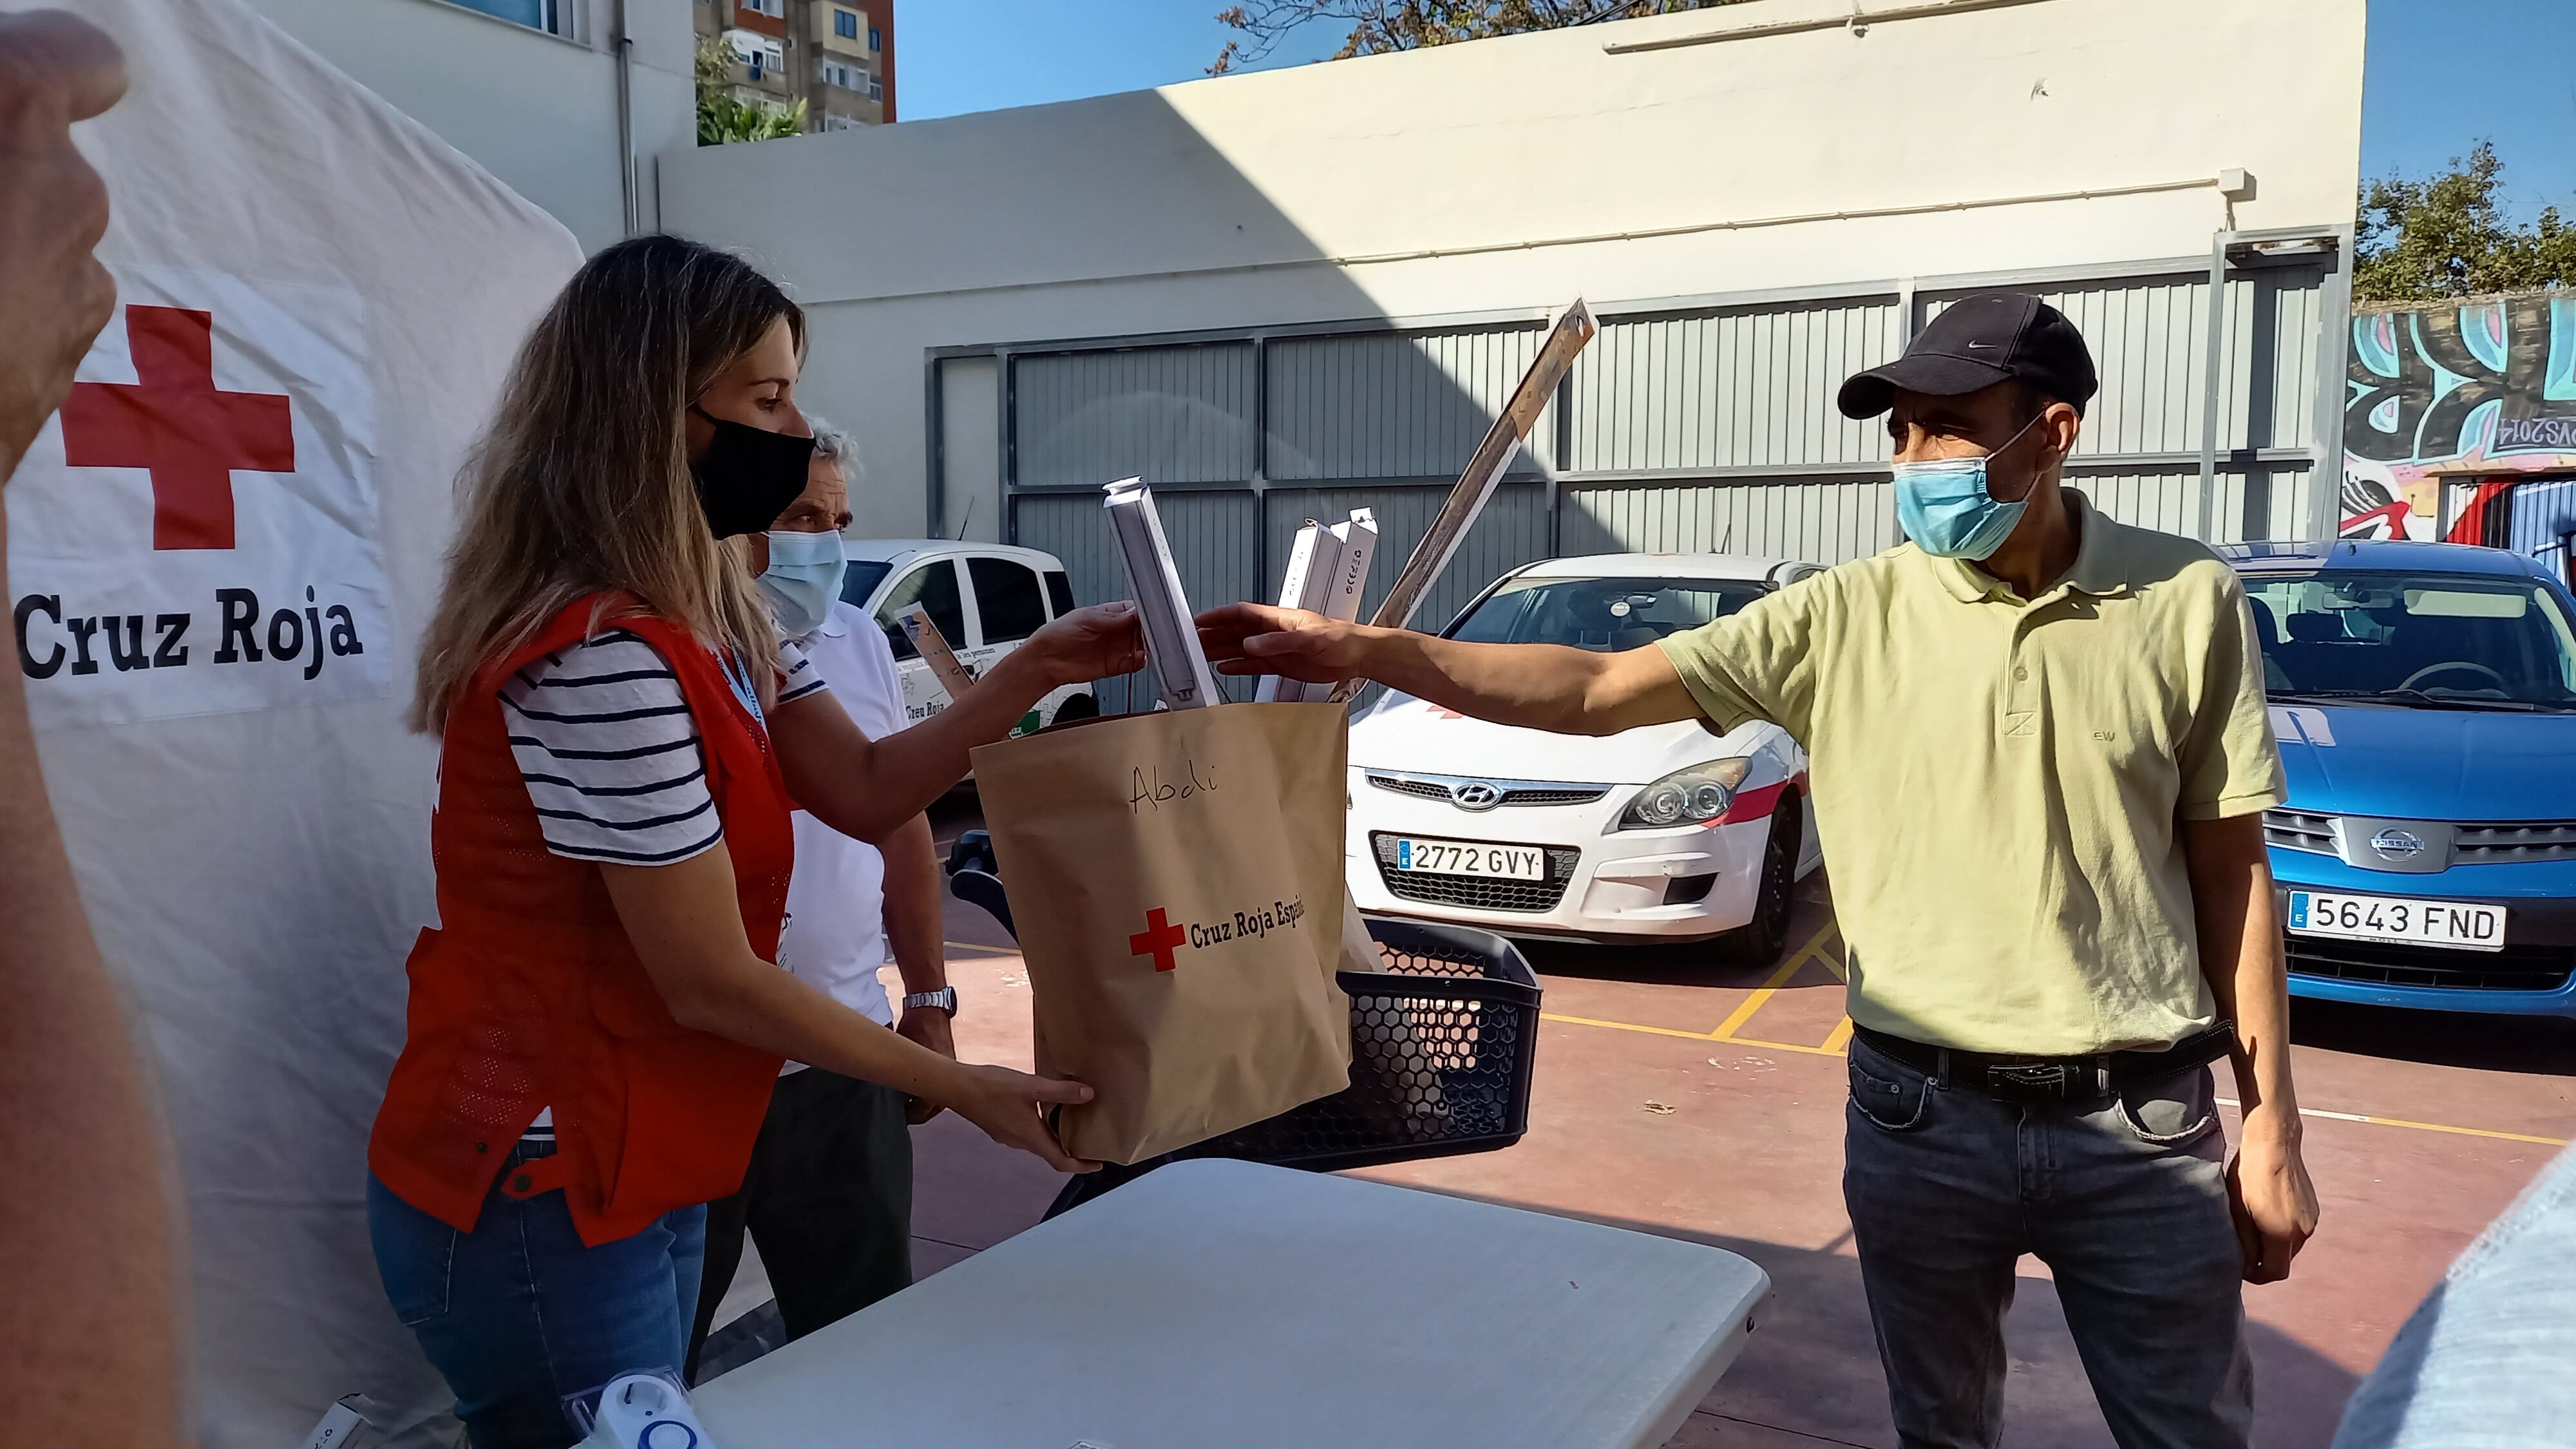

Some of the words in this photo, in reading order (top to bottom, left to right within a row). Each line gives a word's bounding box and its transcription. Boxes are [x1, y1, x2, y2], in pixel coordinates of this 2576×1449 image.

[14, 593, 191, 680] Cruz
[214, 584, 363, 681] Roja
[1129, 759, 1218, 815] Abdi
[1416, 844, 1479, 871] 2772
[1489, 850, 1536, 875] GVY
[1190, 923, 1232, 949] Cruz
[1234, 906, 1274, 939] Roja
[2295, 914, 2303, 922] E
[2316, 898, 2409, 933] 5643
[2424, 907, 2494, 940] FND
